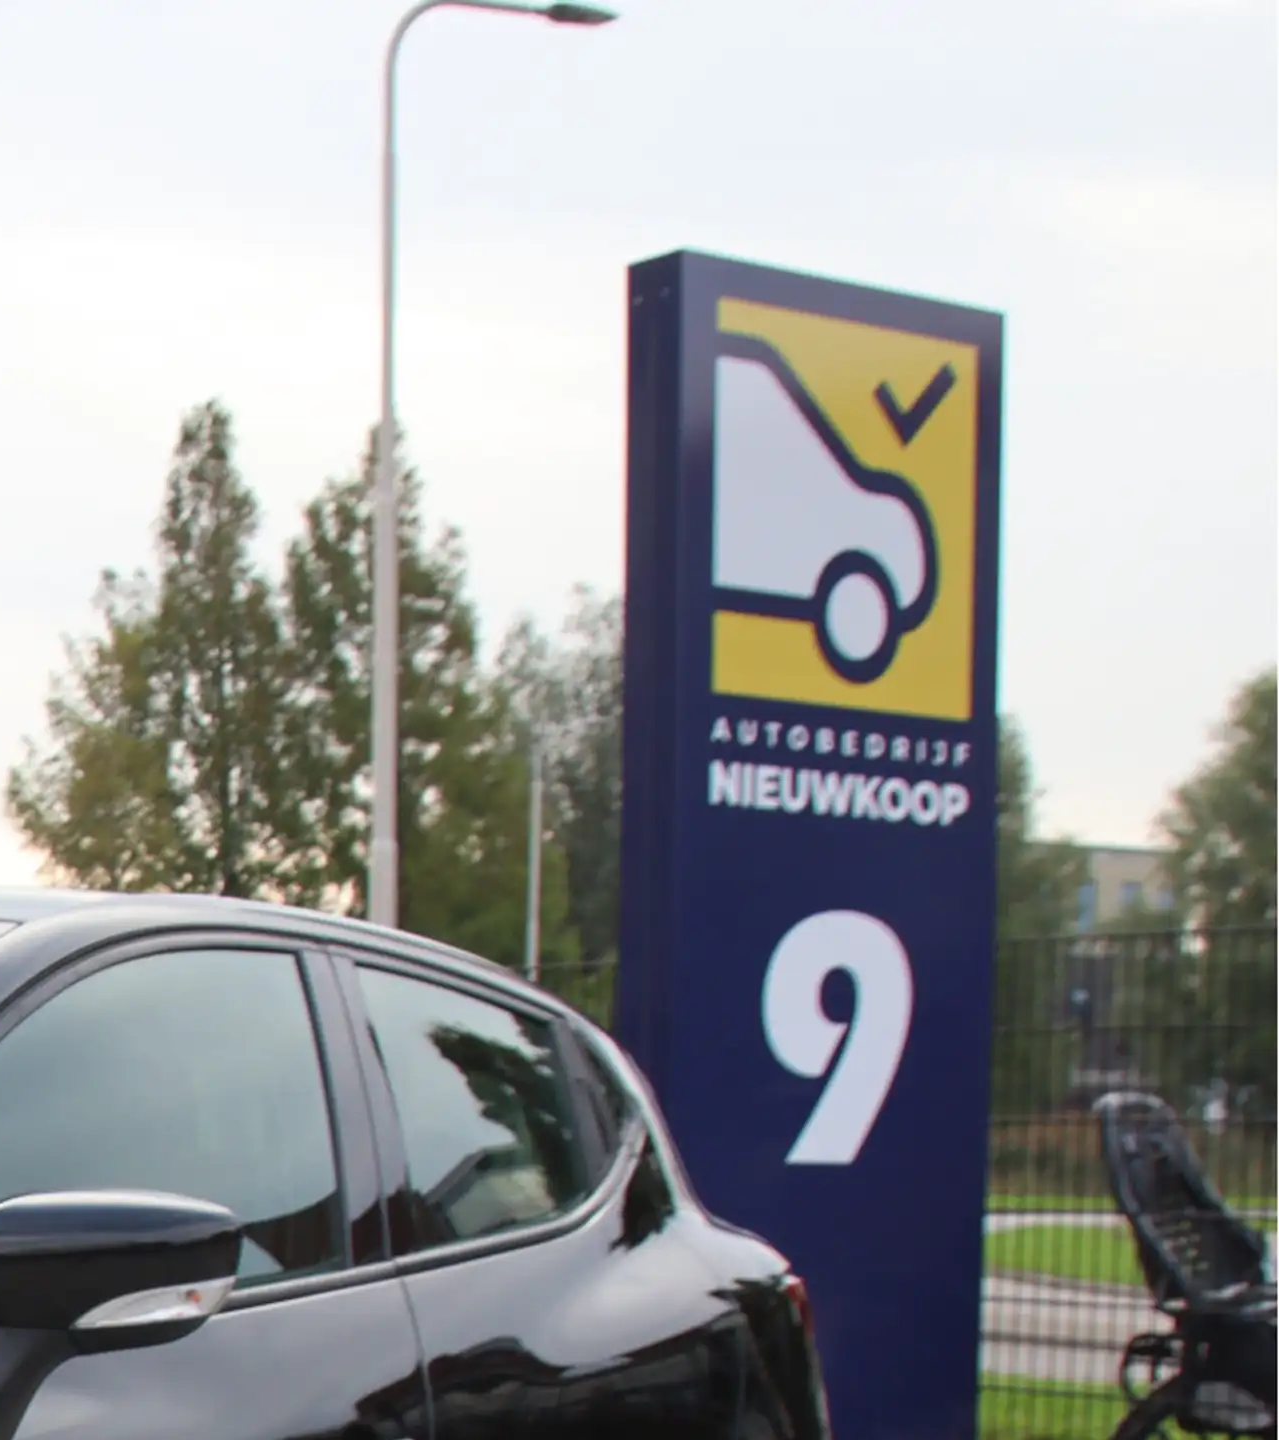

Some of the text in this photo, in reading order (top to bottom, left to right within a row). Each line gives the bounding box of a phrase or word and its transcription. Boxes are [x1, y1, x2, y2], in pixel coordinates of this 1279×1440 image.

[709, 716, 972, 768] AUTOBEDRIJF
[708, 760, 970, 827] NIEUWKOOP
[760, 908, 915, 1166] 9
